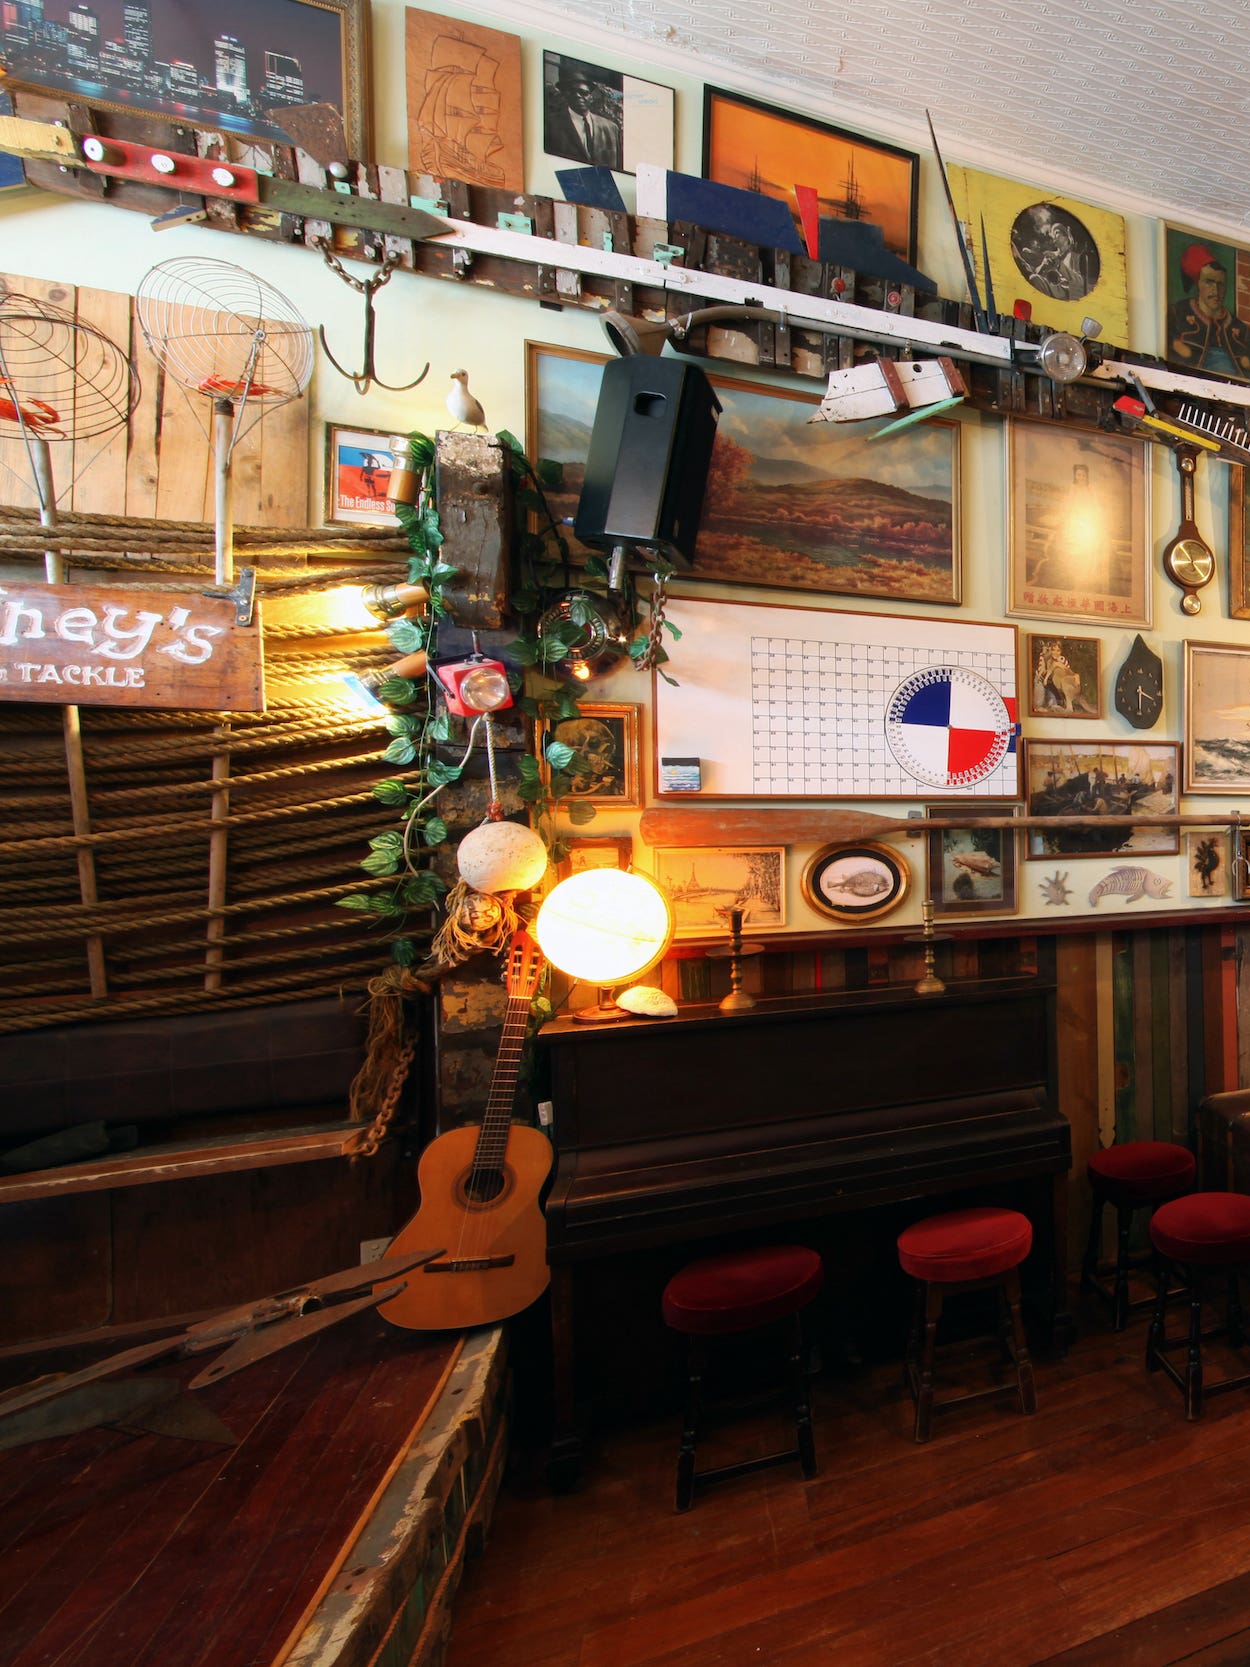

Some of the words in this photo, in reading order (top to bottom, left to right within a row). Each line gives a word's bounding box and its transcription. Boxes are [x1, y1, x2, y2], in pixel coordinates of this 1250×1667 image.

[341, 495, 355, 507] The
[355, 497, 385, 511] Endless
[0, 587, 227, 664] ney's
[13, 662, 146, 688] TACKLE
